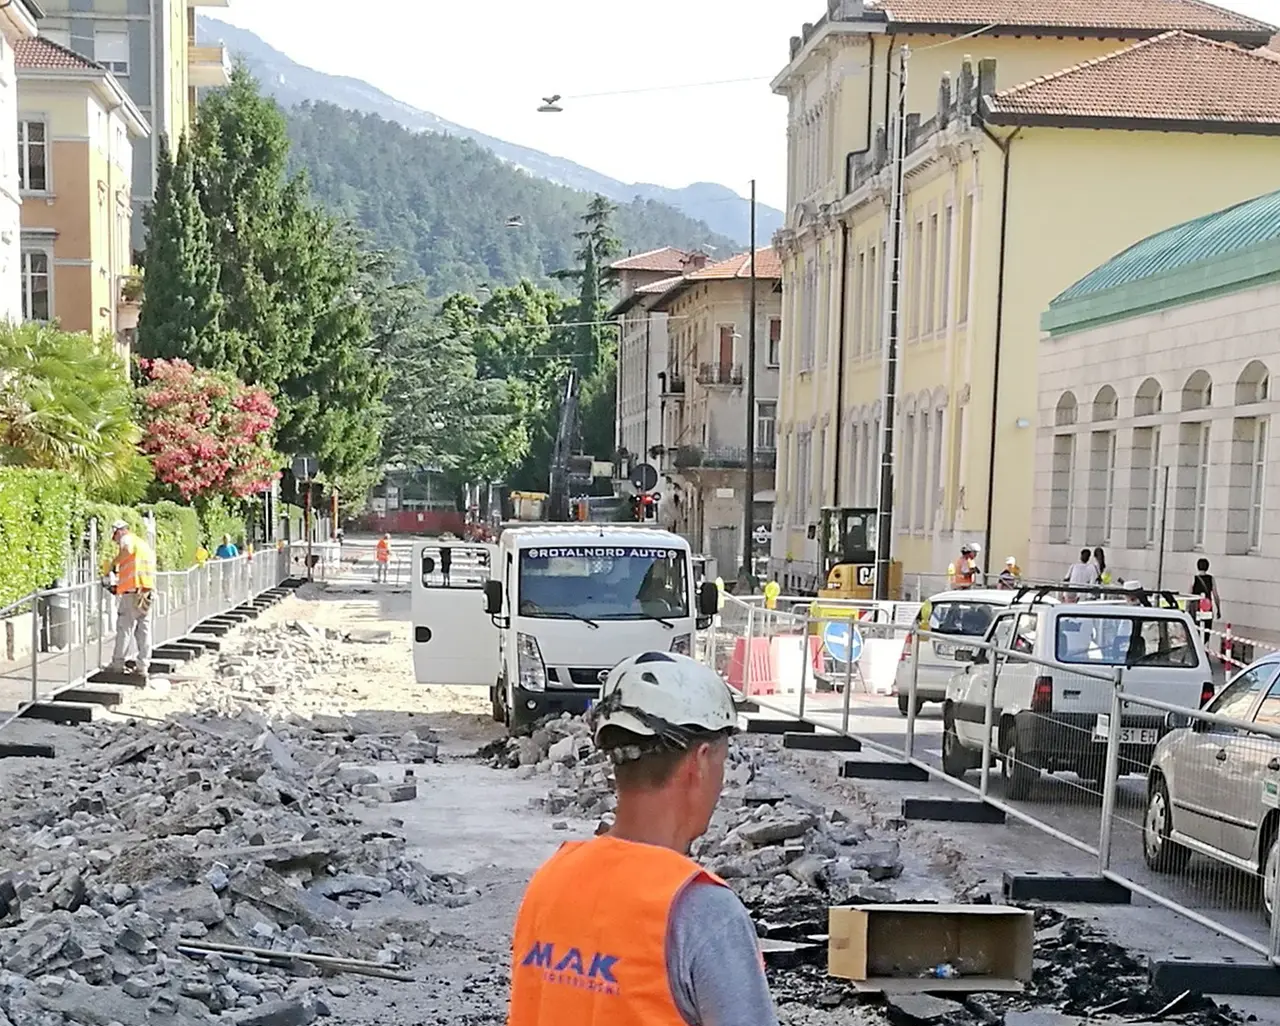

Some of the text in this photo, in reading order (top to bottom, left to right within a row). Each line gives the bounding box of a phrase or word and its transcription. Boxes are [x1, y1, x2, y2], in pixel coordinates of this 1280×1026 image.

[539, 548, 666, 558] ROTALNORD AUTO
[522, 941, 620, 983] MAK
